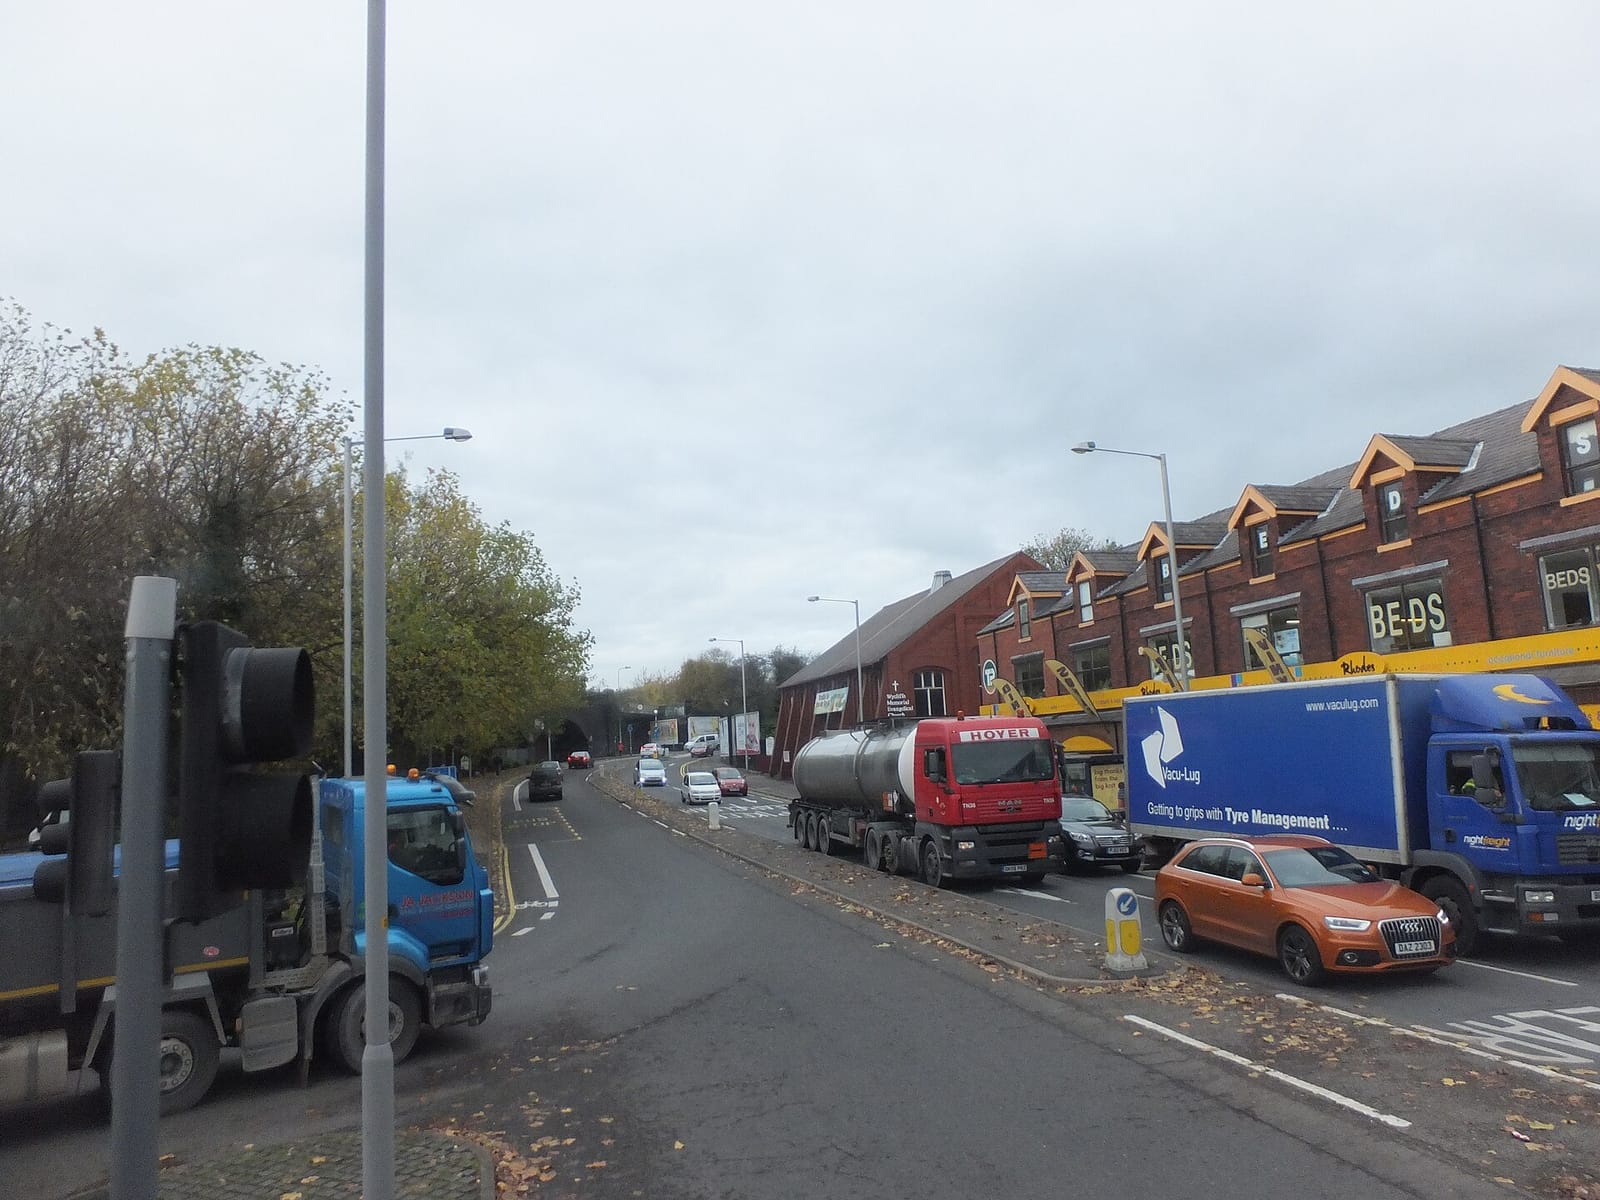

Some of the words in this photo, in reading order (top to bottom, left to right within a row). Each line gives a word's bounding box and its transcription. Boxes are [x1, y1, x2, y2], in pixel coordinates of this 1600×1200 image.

[1576, 432, 1591, 454] S
[1388, 490, 1401, 510] D
[1258, 531, 1268, 548] E
[1161, 563, 1169, 578] B
[1545, 566, 1591, 591] BEDS
[1369, 592, 1446, 639] BEDS
[1340, 655, 1376, 675] Rhodes
[1305, 698, 1379, 712] www.vaculug.com
[970, 728, 1030, 741] HOYER
[1162, 766, 1201, 785] Vacu-Lug
[1147, 802, 1174, 819] Getting
[1175, 804, 1183, 817] to
[1184, 805, 1204, 821] grips
[1205, 806, 1223, 821] with
[1225, 807, 1249, 825] Tyre
[1251, 808, 1329, 830] Management
